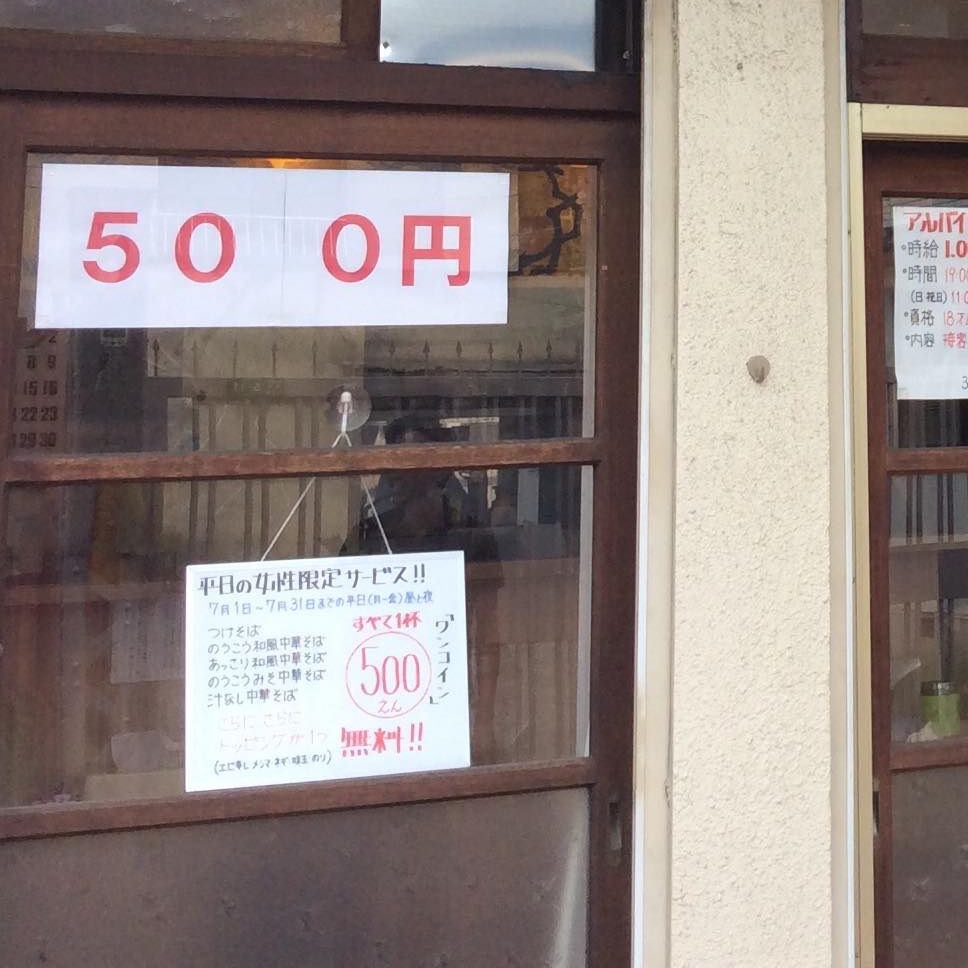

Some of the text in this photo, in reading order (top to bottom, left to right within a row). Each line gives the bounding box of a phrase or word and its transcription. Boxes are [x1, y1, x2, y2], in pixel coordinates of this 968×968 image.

[910, 333, 935, 349] 内容
[207, 624, 262, 638] つけそば
[360, 647, 420, 696] 500
